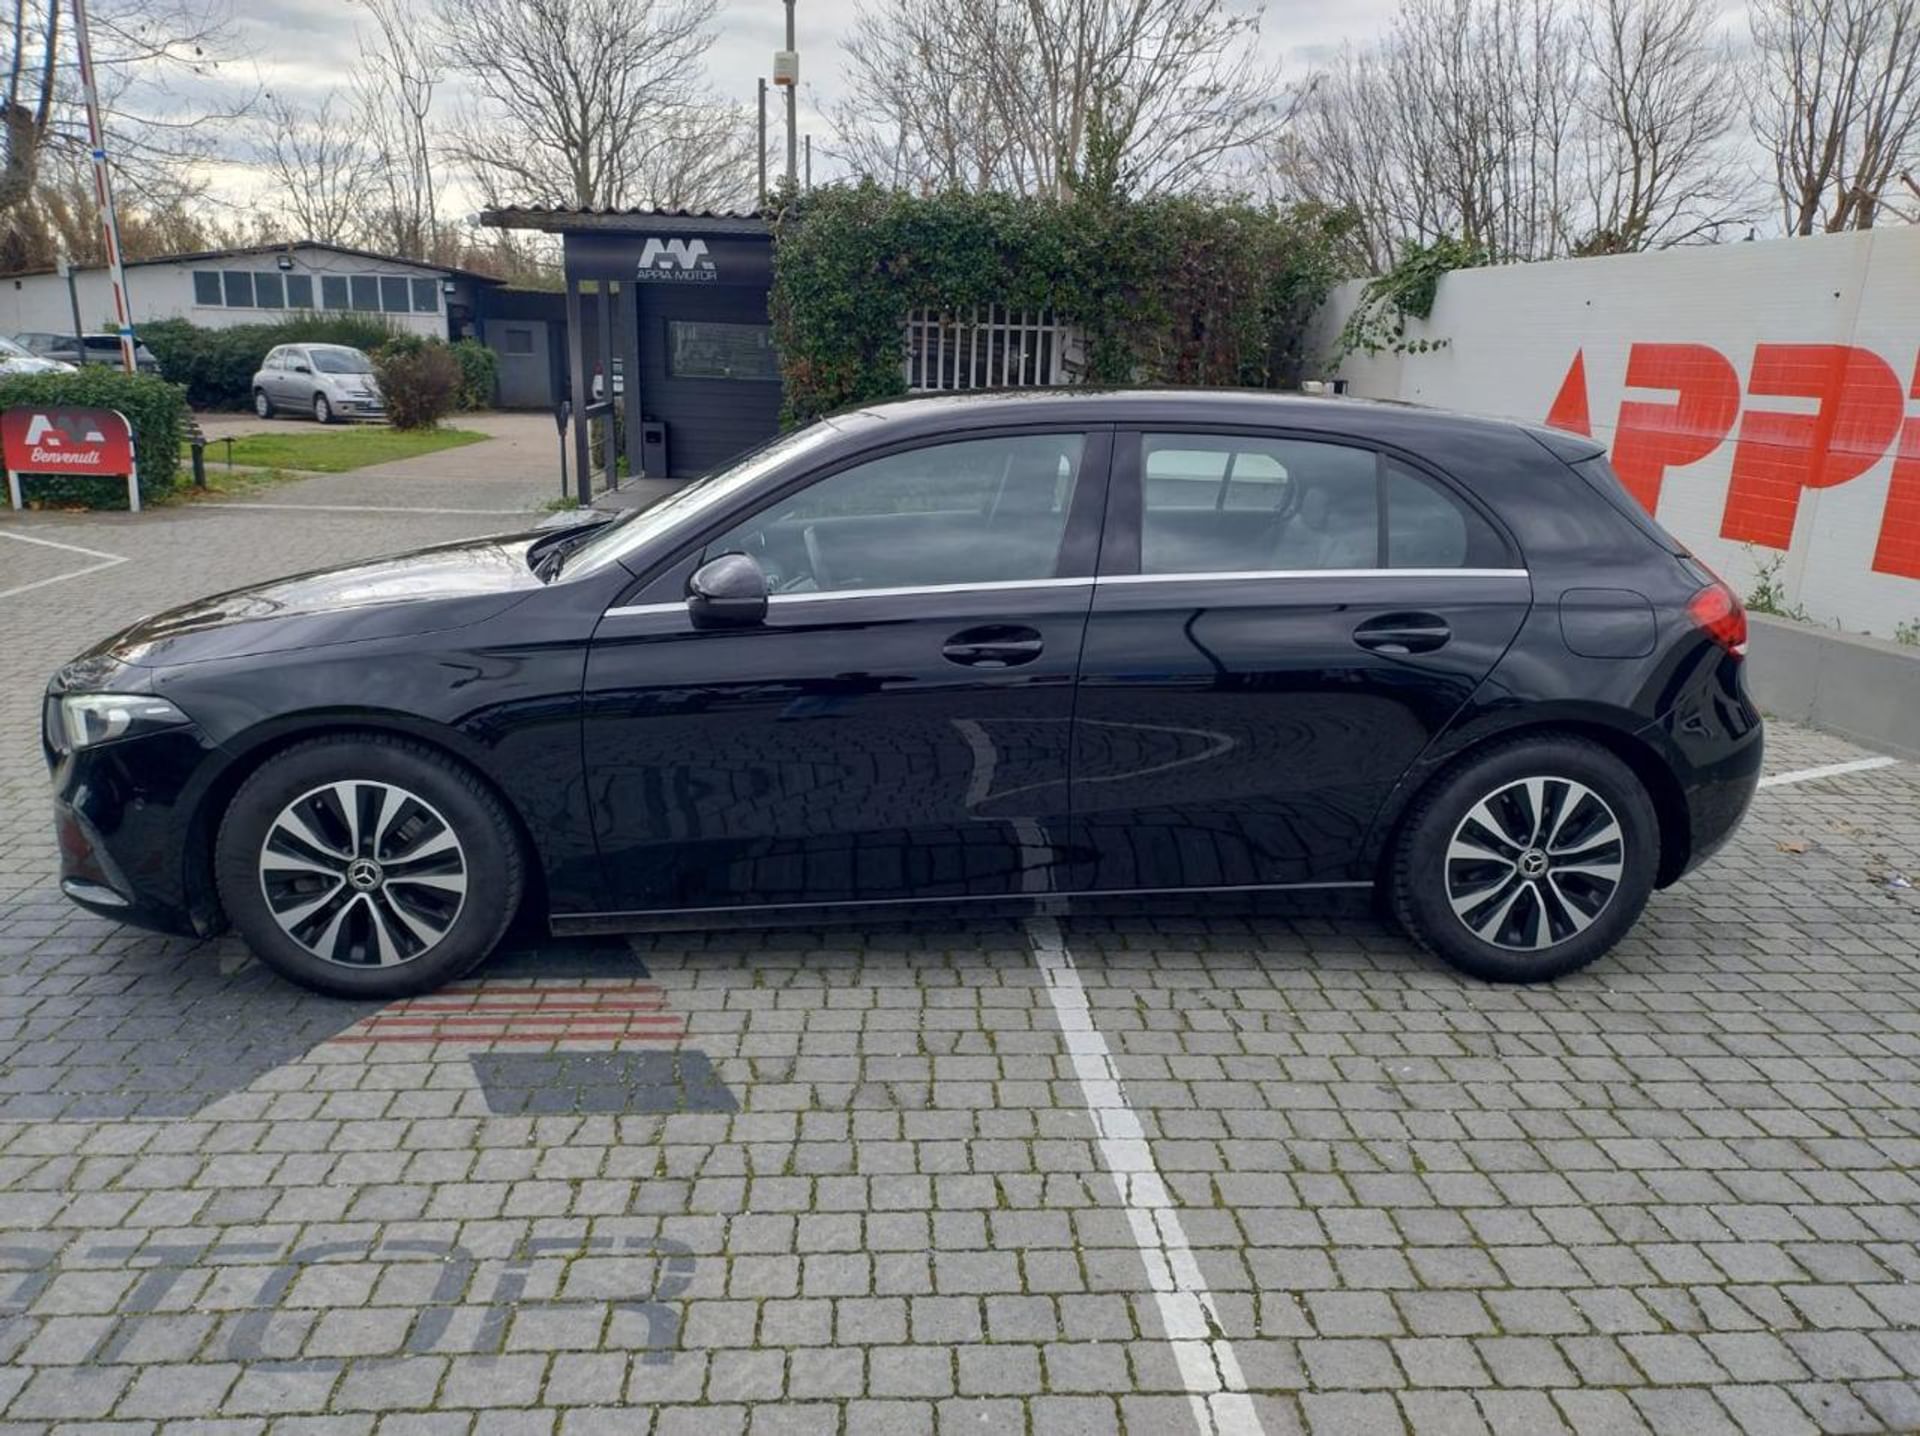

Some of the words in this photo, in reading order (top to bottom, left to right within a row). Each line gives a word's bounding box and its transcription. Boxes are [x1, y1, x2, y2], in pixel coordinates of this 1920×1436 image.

[637, 269, 673, 280] APPIA
[674, 271, 718, 281] MOTOR
[31, 447, 101, 465] Benvenuti
